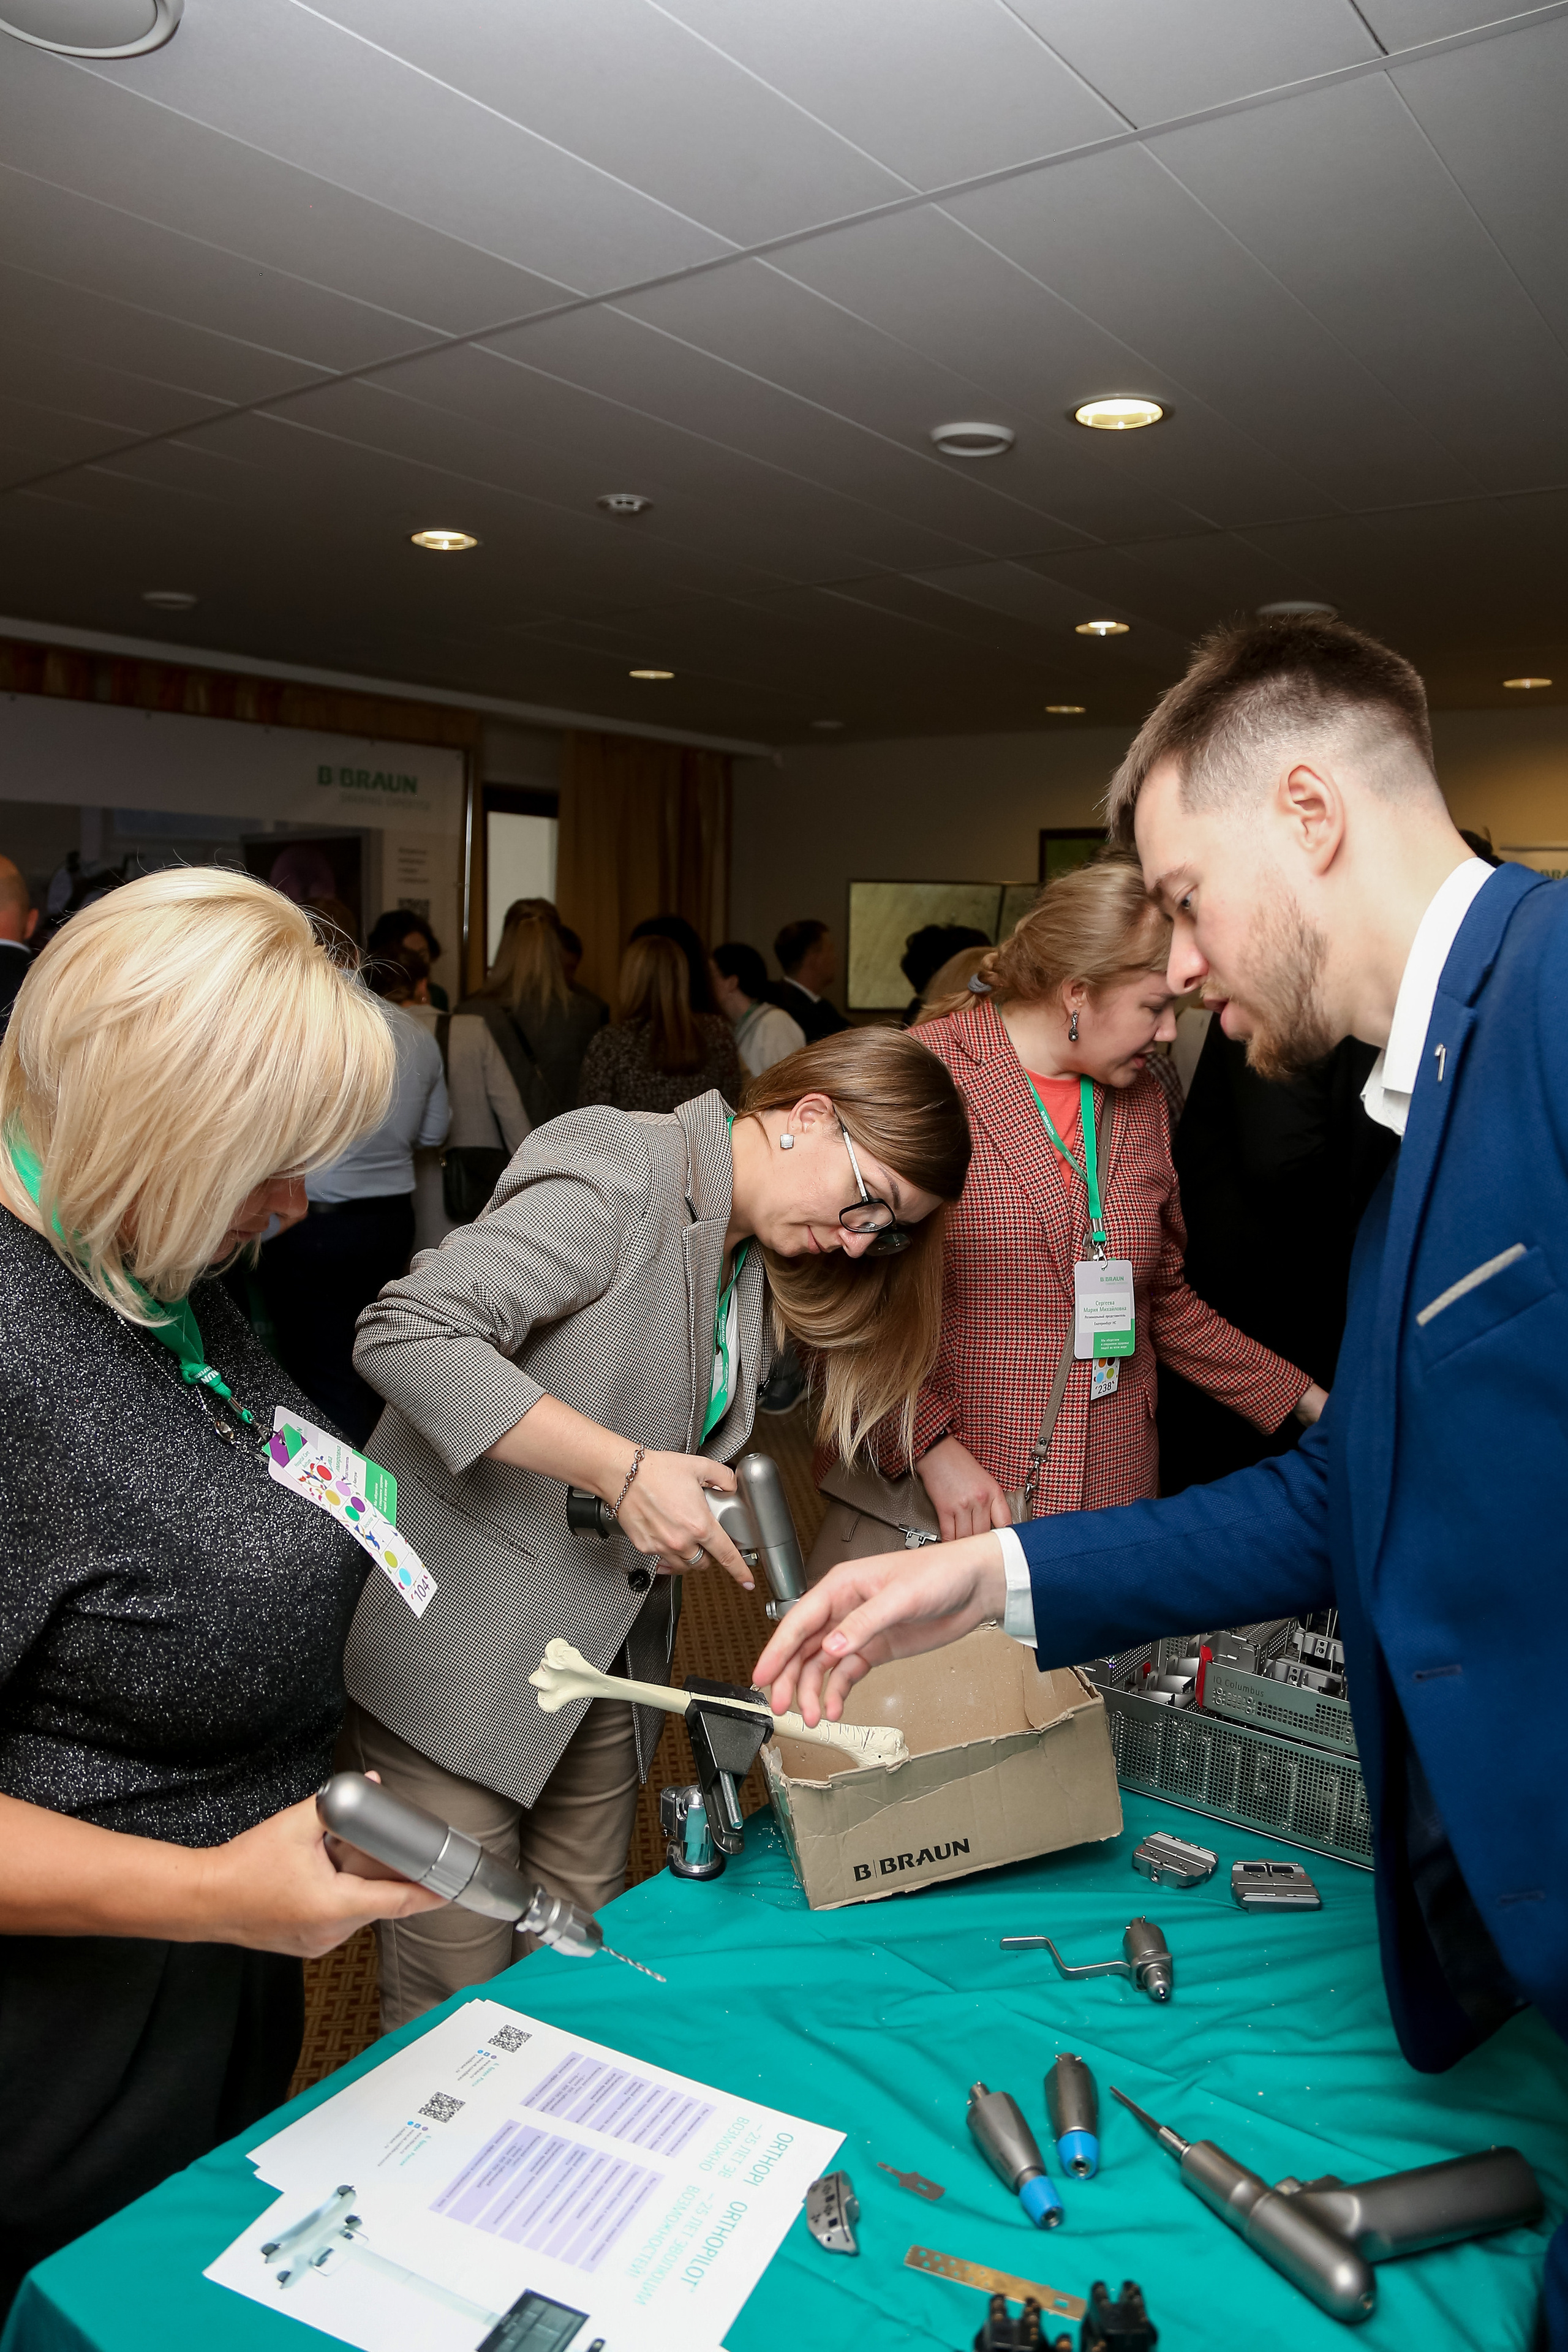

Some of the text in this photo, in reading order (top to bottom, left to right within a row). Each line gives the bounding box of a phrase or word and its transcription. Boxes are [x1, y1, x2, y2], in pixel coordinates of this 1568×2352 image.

[339, 767, 418, 794] BRAUN
[1043, 1115, 1055, 1136] BRAUN
[1098, 1382, 1112, 1395] 238
[414, 1578, 430, 1602] 104
[1213, 1675, 1264, 1697] IQ Columbus
[879, 1838, 970, 1875] BRAUN
[743, 2131, 761, 2146] 25
[728, 2144, 749, 2165] ЛЕТ
[693, 2201, 712, 2217] 25
[679, 2215, 702, 2238] ЛЕТ
[632, 2239, 687, 2307] ЭВОЛЮЦИИ
